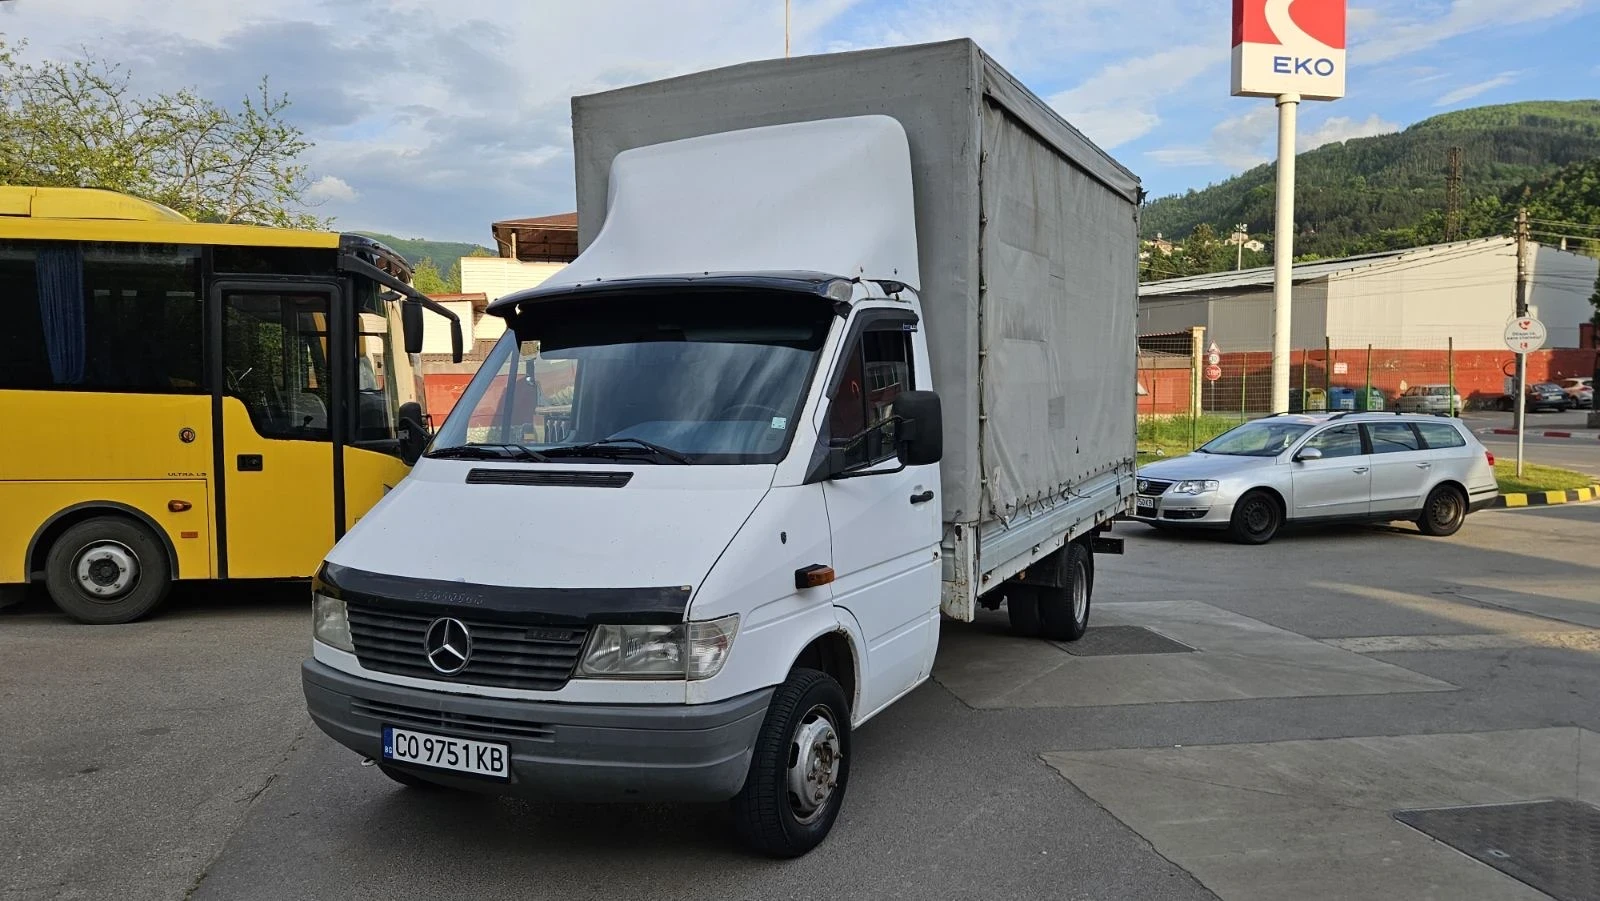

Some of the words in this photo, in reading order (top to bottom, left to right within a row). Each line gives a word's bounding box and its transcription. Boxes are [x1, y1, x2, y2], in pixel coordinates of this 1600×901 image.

[1273, 56, 1334, 76] EKO
[1207, 369, 1220, 377] STOP
[384, 745, 393, 754] BG
[424, 738, 470, 768] 9751
[476, 745, 504, 773] KB
